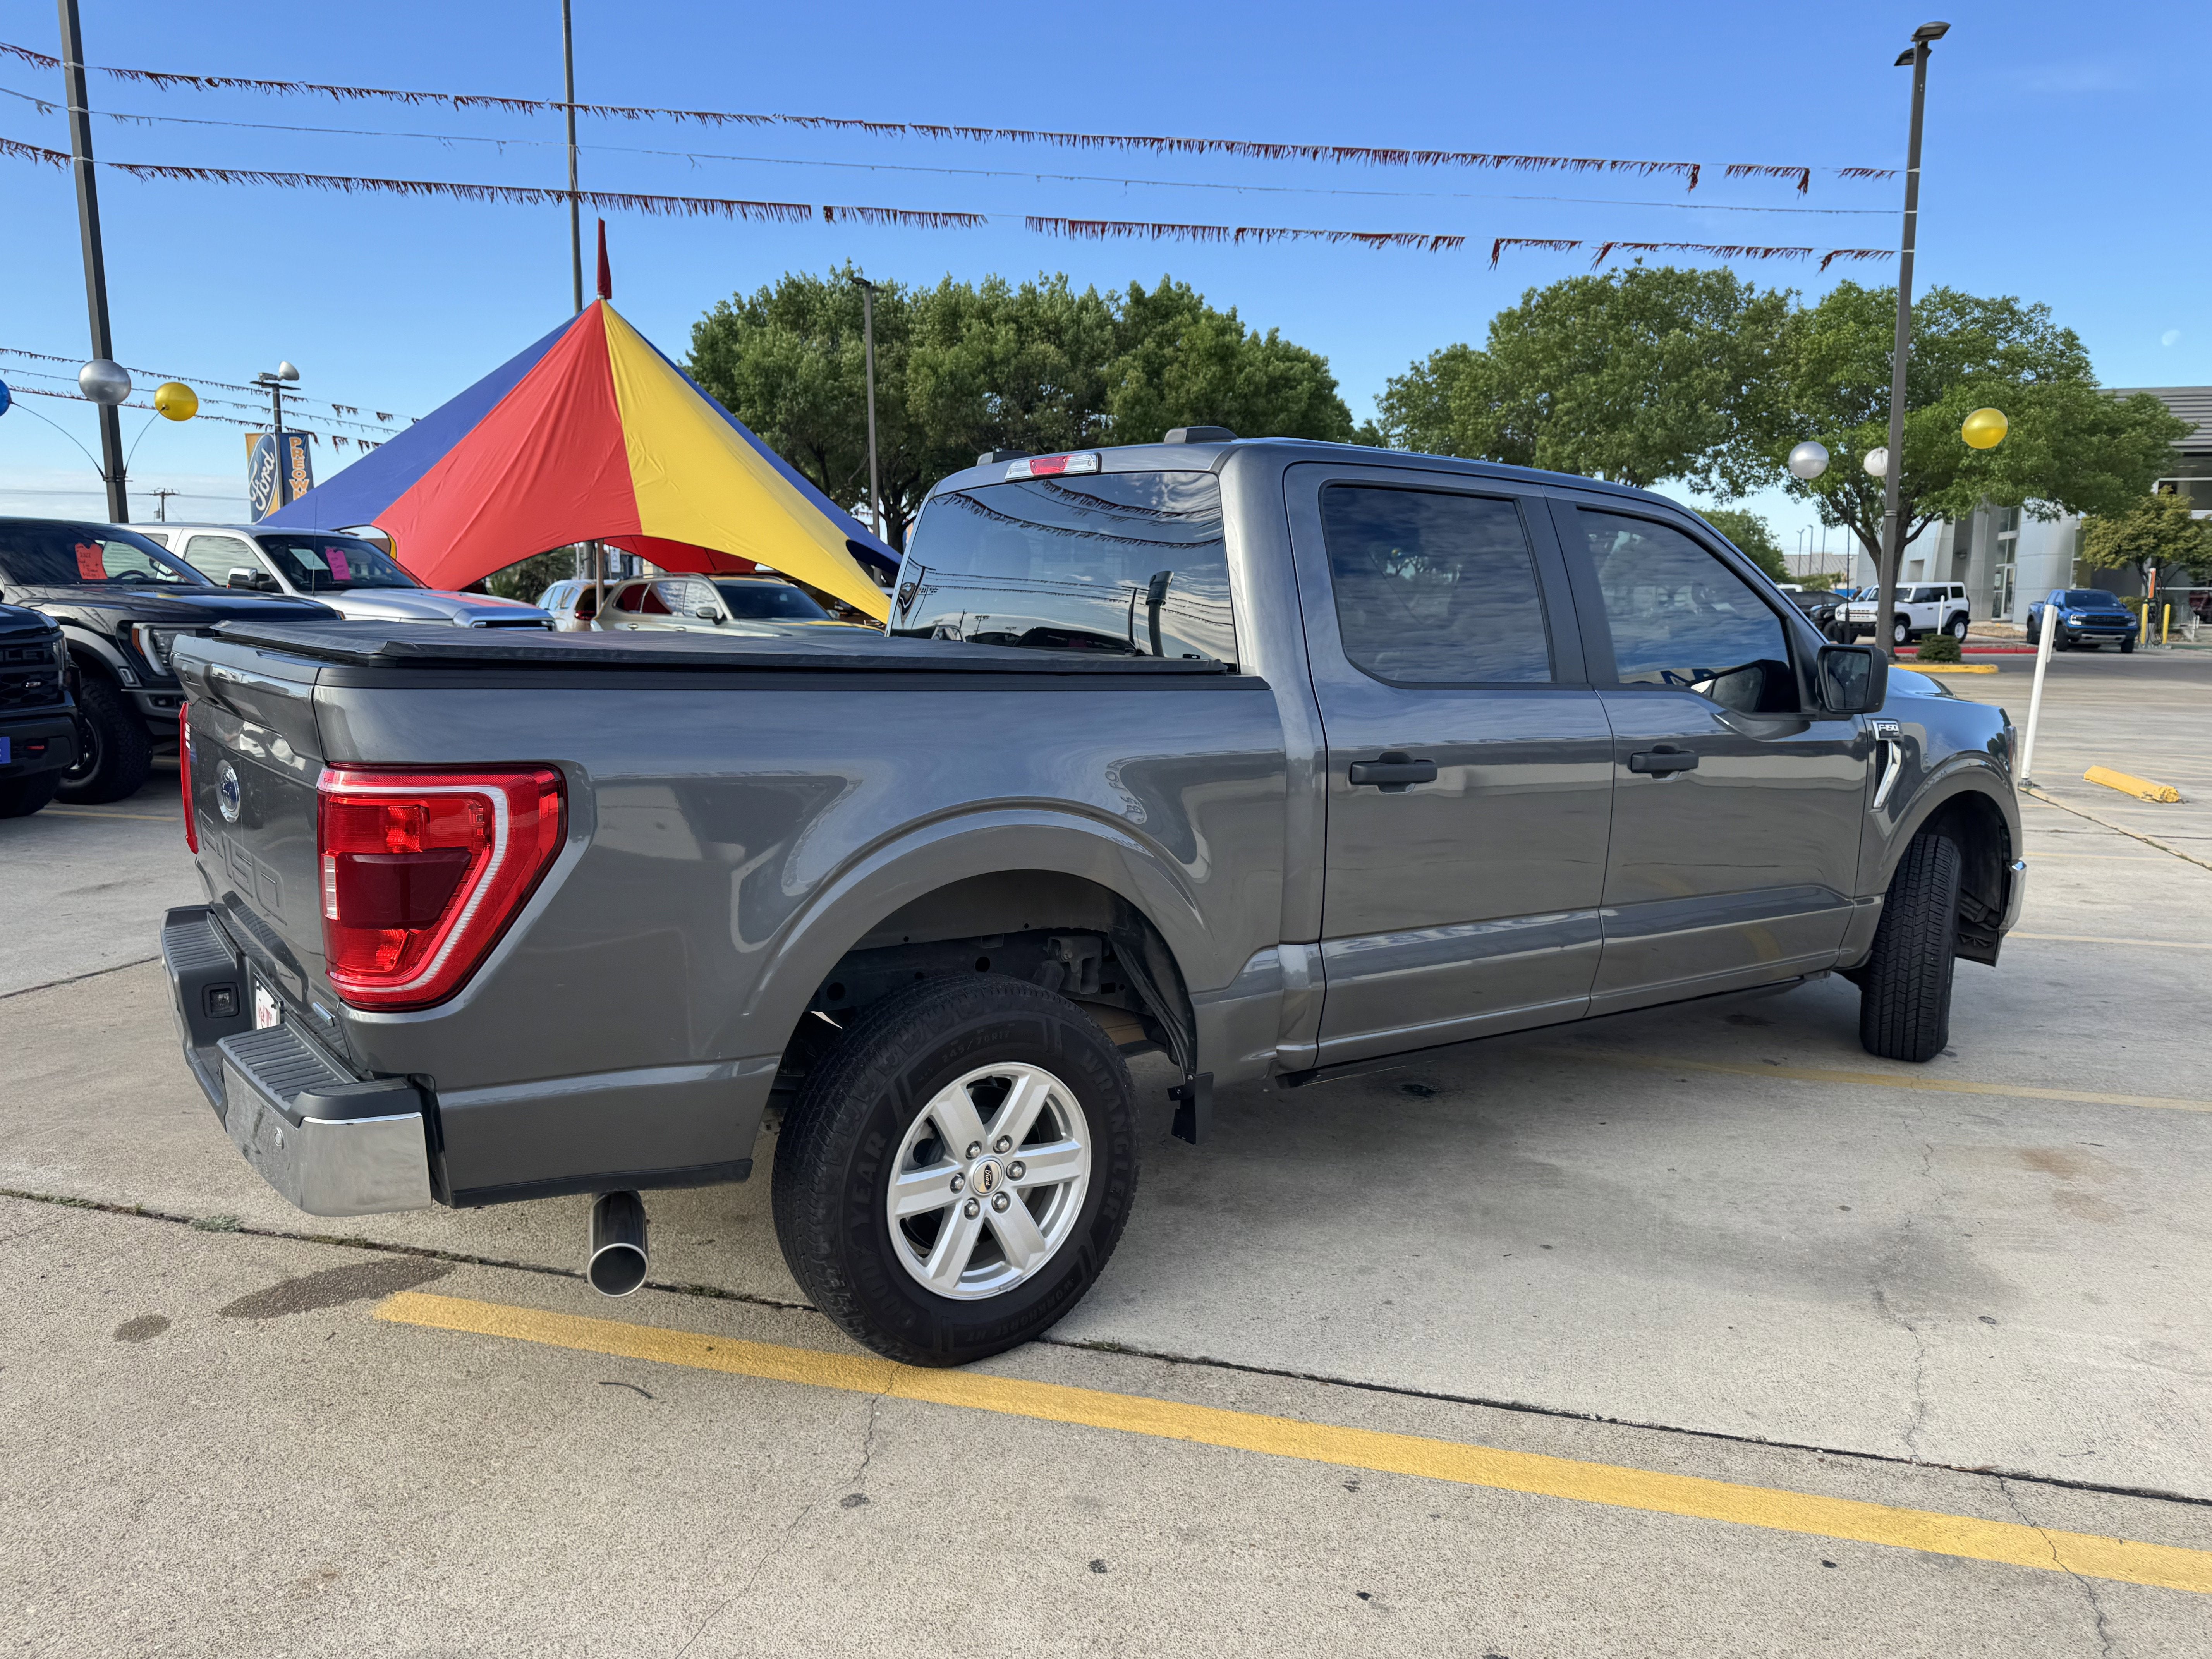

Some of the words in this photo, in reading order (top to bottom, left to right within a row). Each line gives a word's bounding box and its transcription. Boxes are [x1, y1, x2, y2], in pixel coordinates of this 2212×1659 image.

[249, 448, 276, 511] Ford
[0, 648, 50, 662] LET
[942, 1030, 1011, 1063] 245/70R17
[1080, 1048, 1130, 1221] WRANGLER
